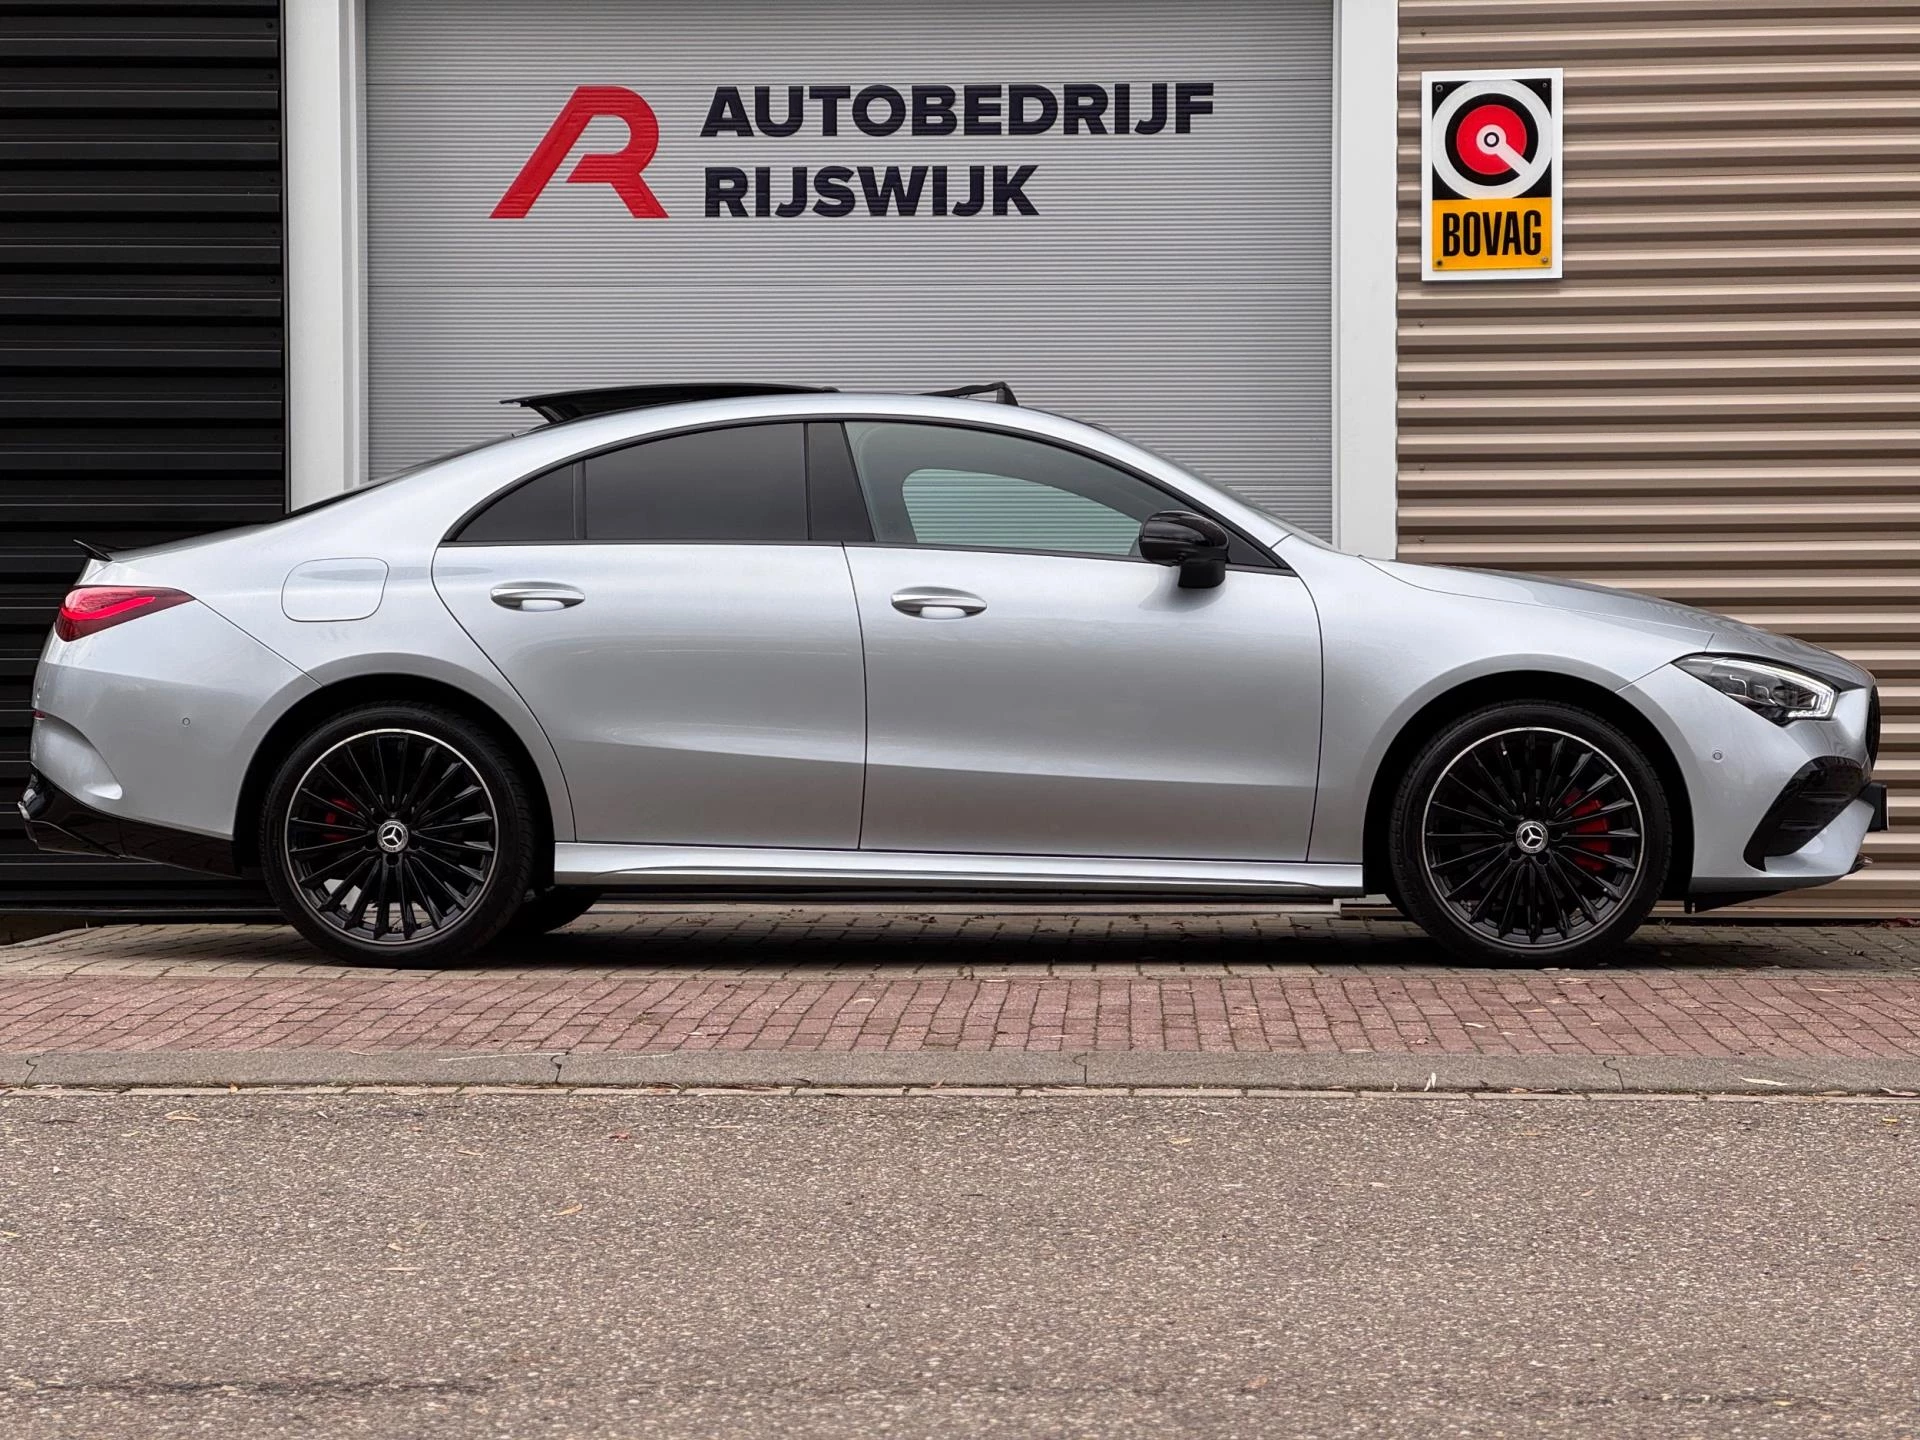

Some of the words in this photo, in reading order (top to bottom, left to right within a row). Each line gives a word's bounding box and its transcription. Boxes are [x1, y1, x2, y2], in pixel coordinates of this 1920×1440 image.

[700, 83, 1214, 138] AUTOBEDRIJF
[705, 164, 1040, 218] RIJSWIJK
[1443, 210, 1542, 257] BOVAG
